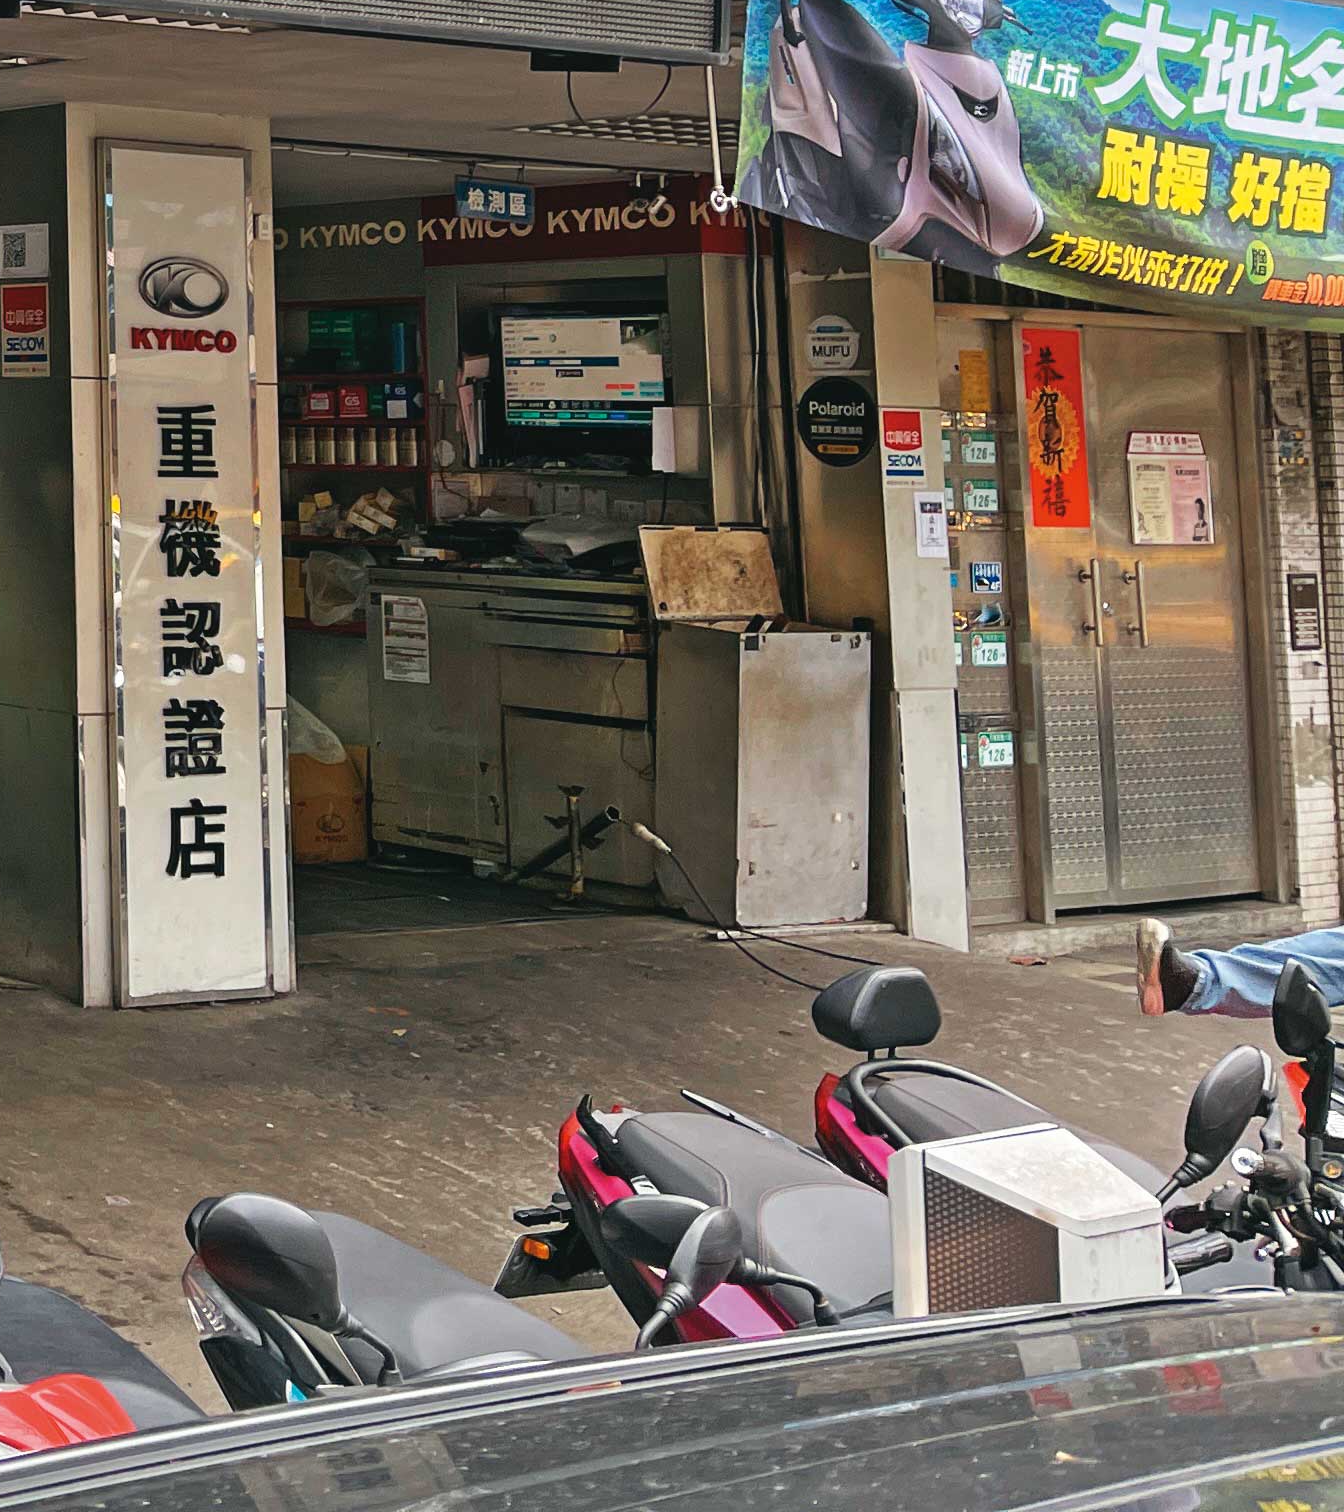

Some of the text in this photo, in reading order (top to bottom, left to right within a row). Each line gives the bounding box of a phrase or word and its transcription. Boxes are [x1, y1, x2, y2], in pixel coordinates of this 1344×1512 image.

[1006, 49, 1081, 98] 新上市
[1097, 127, 1332, 235] 耐操 好擋
[467, 187, 527, 217] 檢測區
[299, 219, 407, 249] KYMCO
[547, 200, 676, 235] KYMCO
[5, 336, 45, 352] SECOM
[130, 326, 237, 354] KYMCO
[812, 344, 851, 358] MUFU
[808, 400, 865, 417] Polaroid
[1032, 345, 1072, 519] 恭賀新禧
[887, 454, 922, 468] SECOM
[970, 447, 988, 460] 126
[973, 494, 990, 507] 126
[155, 403, 228, 881] 重機認證店
[981, 648, 999, 662] 126
[988, 747, 1006, 763] 126
